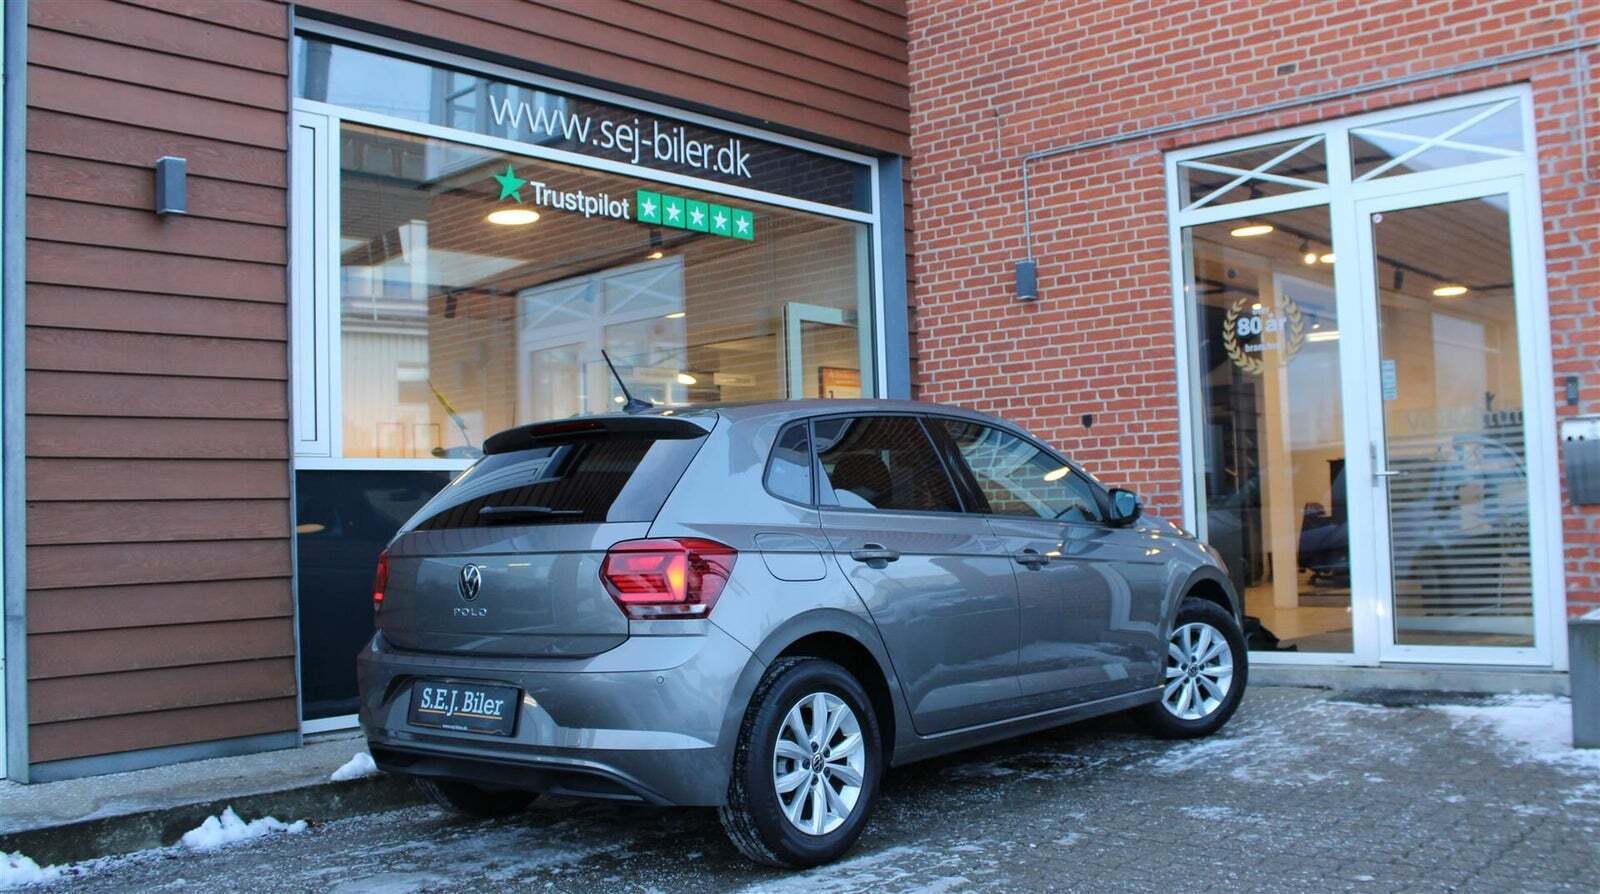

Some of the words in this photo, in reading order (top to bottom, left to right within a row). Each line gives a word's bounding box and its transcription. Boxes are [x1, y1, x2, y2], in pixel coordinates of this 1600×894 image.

[489, 95, 752, 179] www.sej-biler.dk
[530, 181, 630, 220] Trustpilot
[1237, 316, 1262, 336] 80
[453, 607, 488, 617] POLO
[420, 687, 459, 716] S.E.J.
[462, 691, 505, 716] Biler
